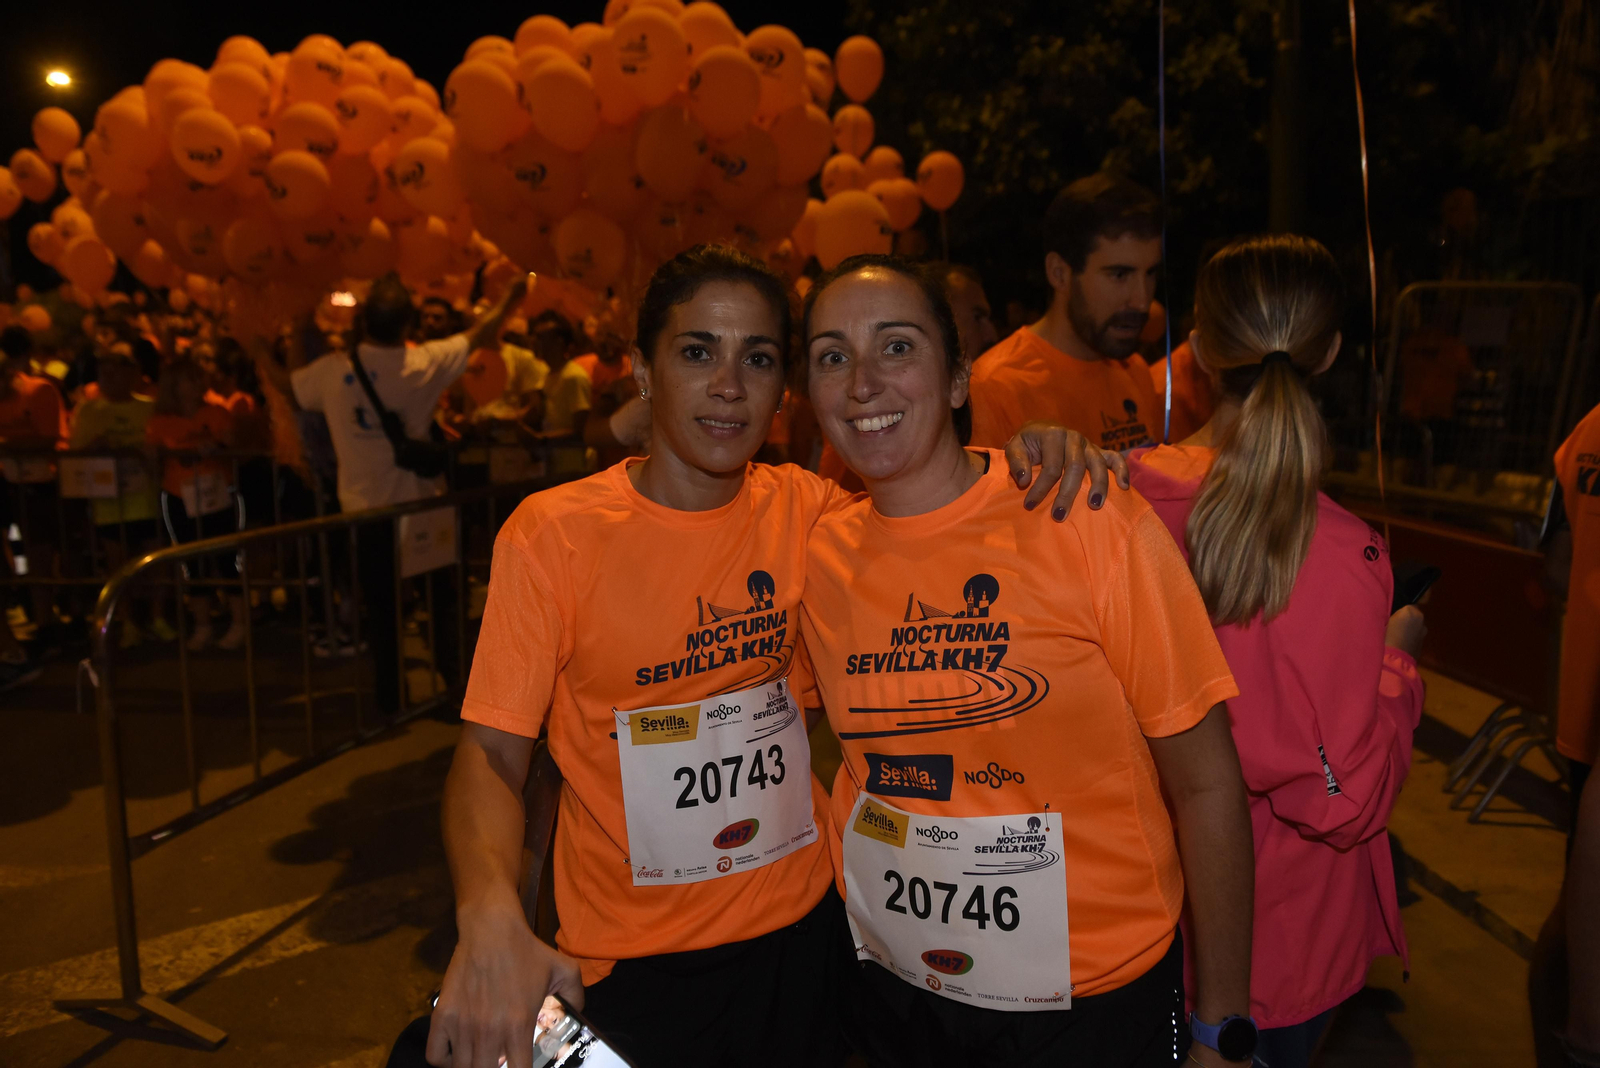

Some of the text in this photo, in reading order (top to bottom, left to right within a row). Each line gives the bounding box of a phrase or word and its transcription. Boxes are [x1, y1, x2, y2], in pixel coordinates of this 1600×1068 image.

[686, 609, 787, 651] NOCTURNA
[890, 622, 1010, 646] NOCTURNA
[635, 648, 738, 686] SEVILLA
[846, 650, 942, 675] SEVILLA
[753, 707, 779, 720] SEVILLA
[673, 744, 786, 809] 20743
[974, 845, 1019, 853] SEVILLA
[996, 835, 1047, 844] NOCTURNA
[883, 869, 1020, 932] 20746
[977, 993, 995, 1001] TORRE
